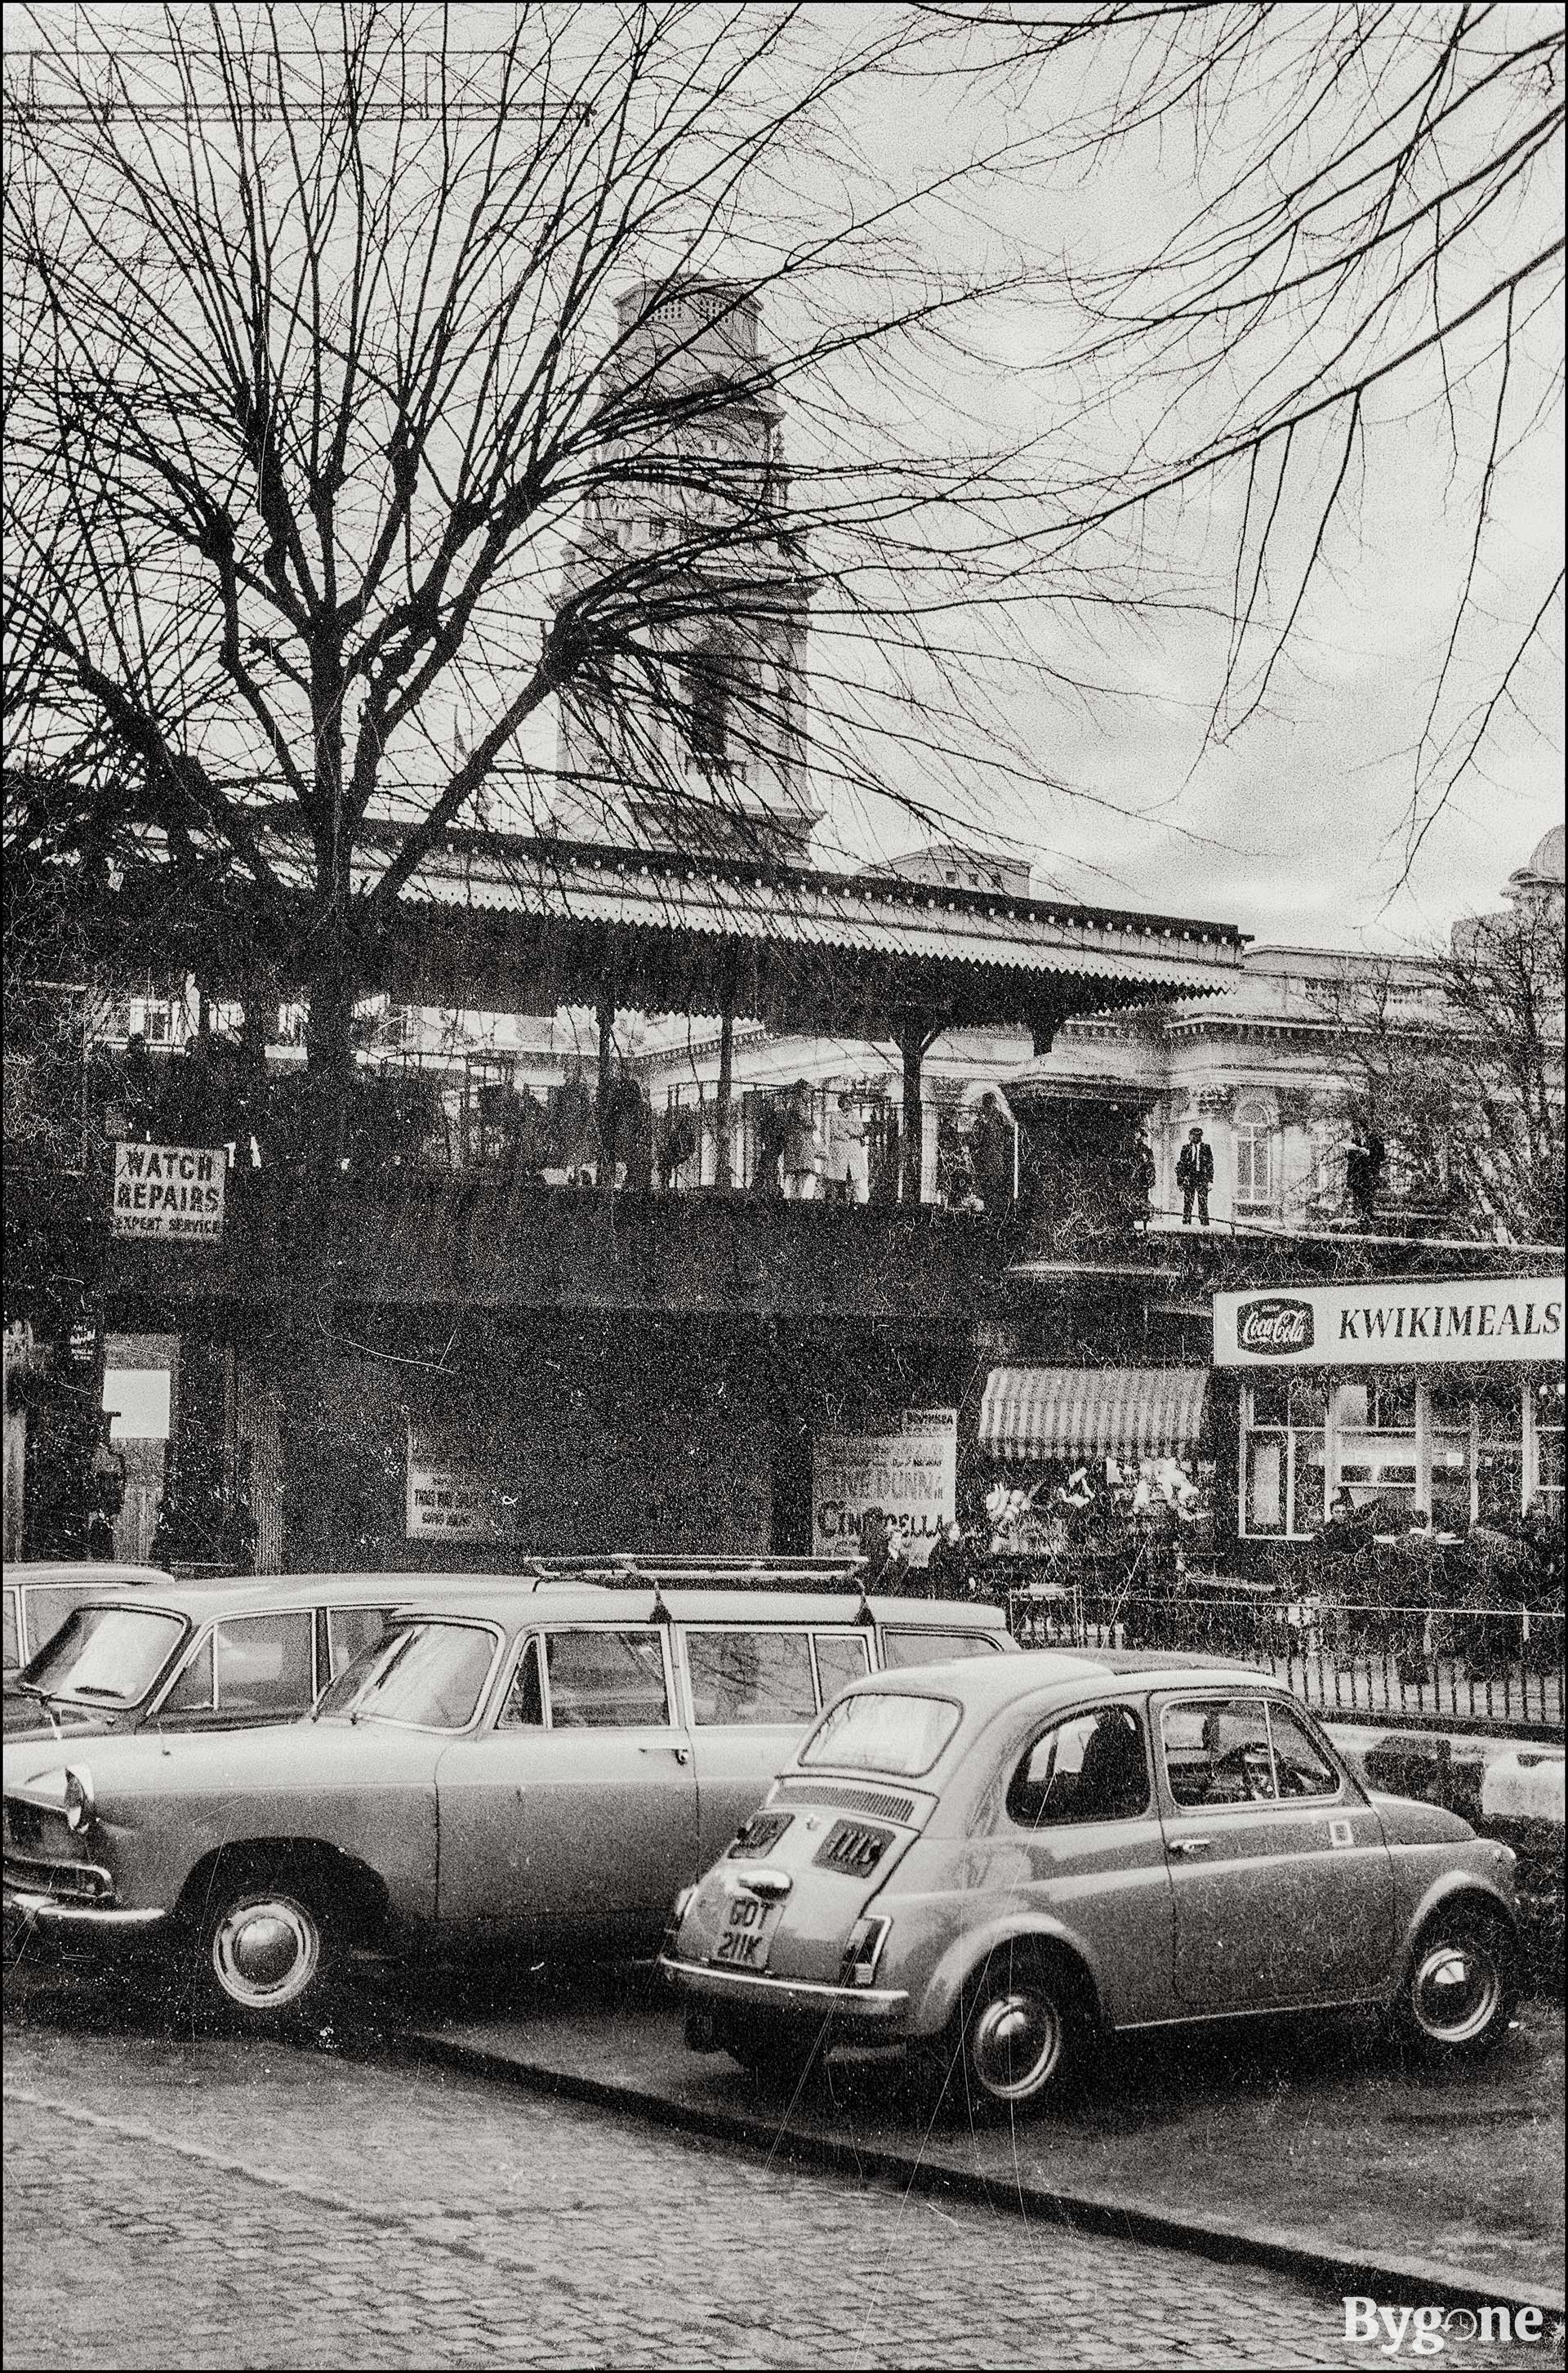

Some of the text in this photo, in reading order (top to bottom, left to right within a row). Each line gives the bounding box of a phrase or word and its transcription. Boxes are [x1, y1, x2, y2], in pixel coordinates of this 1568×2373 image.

[127, 1151, 213, 1181] WATCH
[117, 1183, 220, 1213] REPAIRS
[1338, 1302, 1562, 1339] KWIKIMEALS
[817, 1501, 947, 1538] CINRELLA
[718, 1931, 764, 1964] 211K
